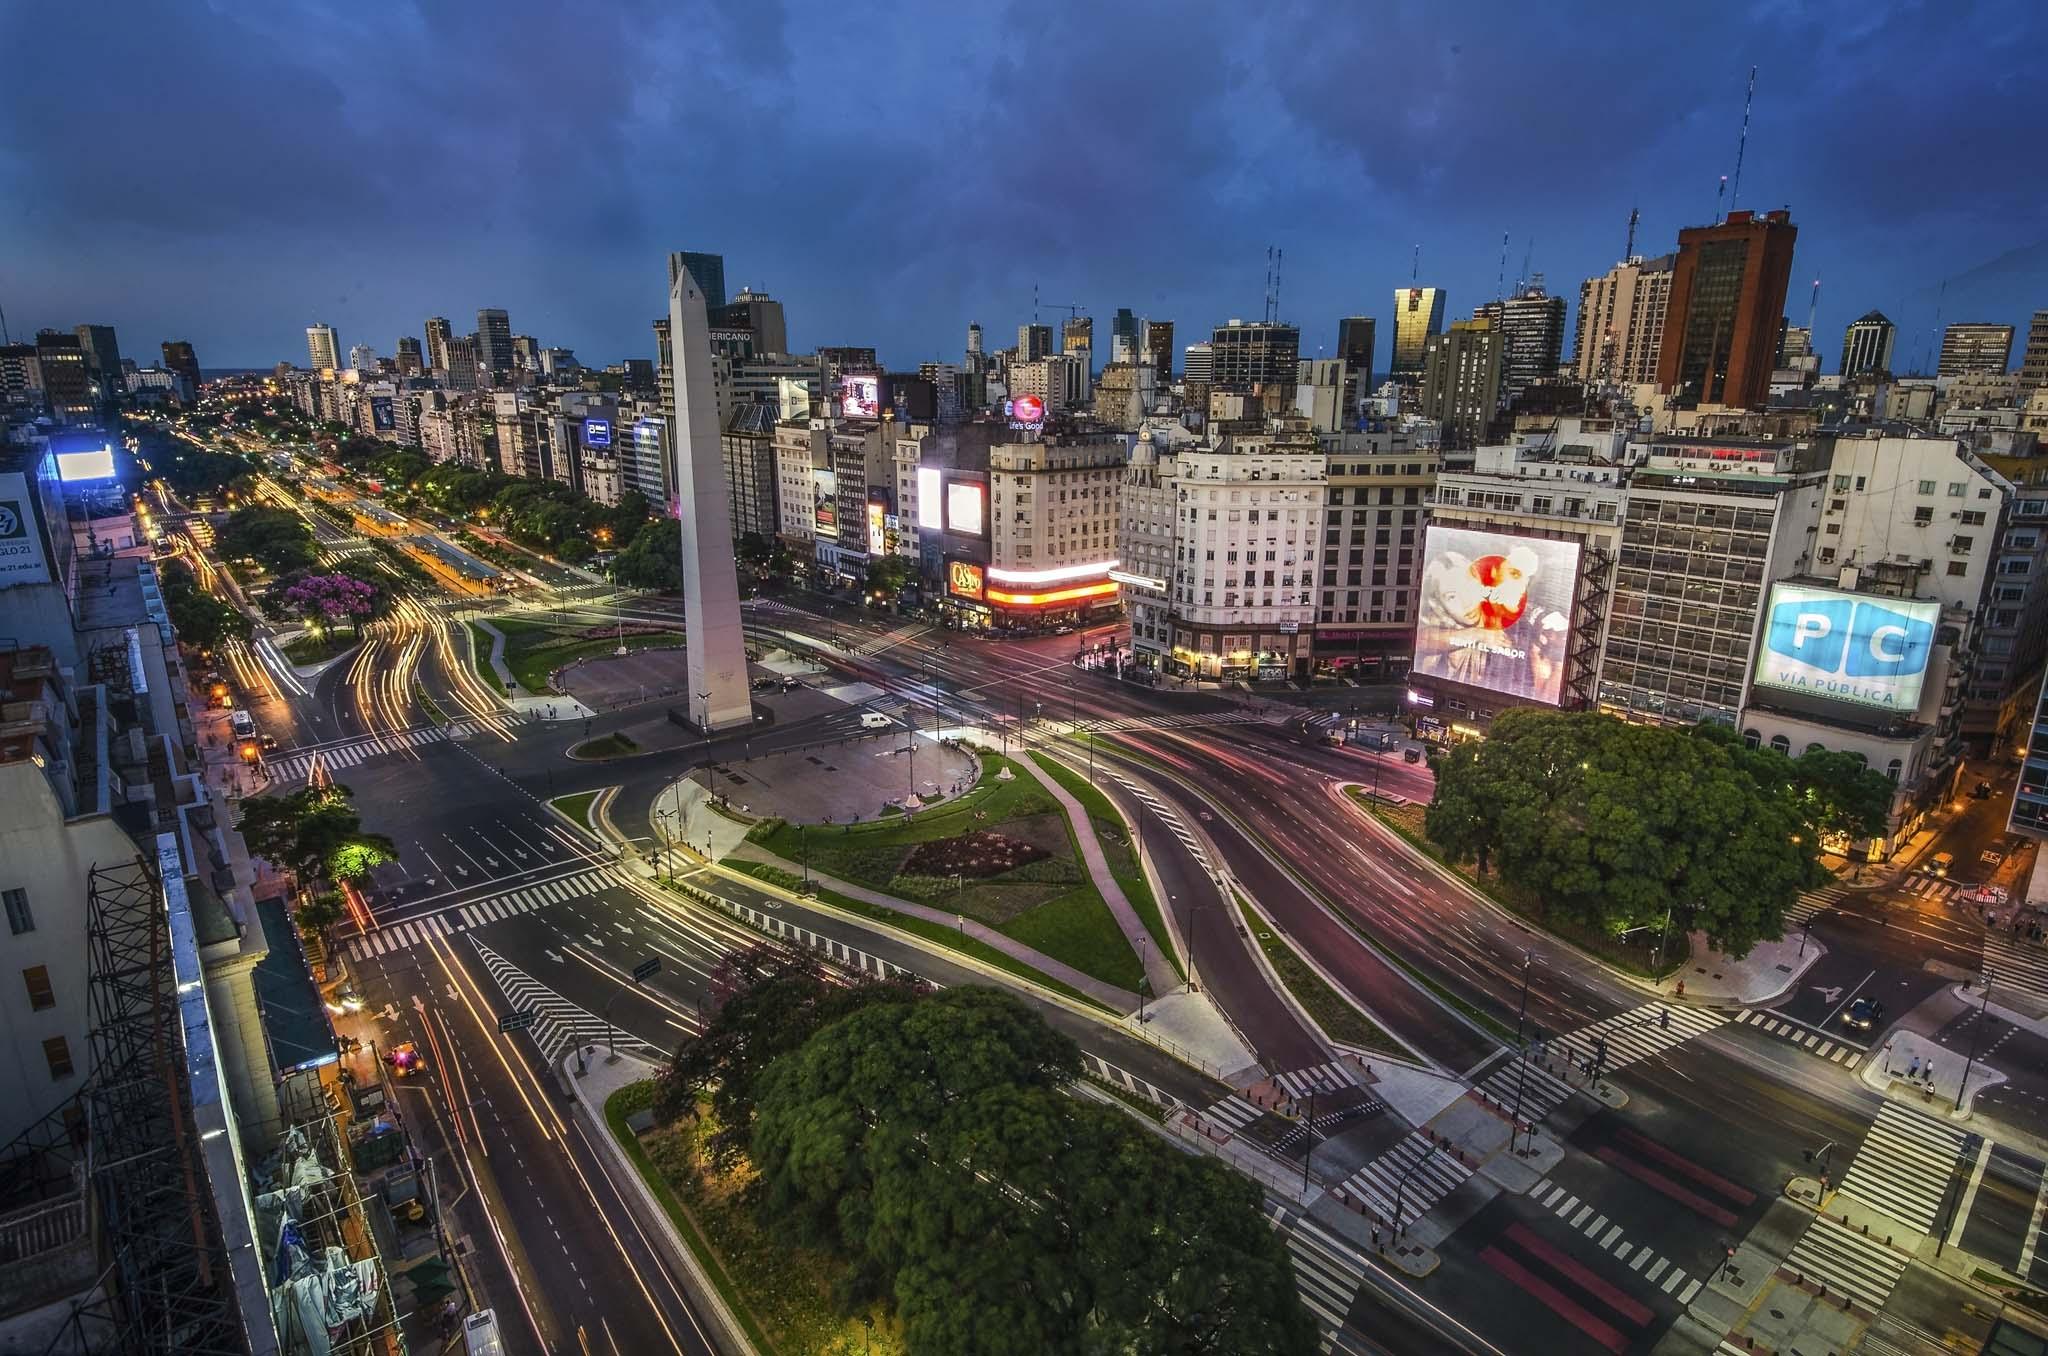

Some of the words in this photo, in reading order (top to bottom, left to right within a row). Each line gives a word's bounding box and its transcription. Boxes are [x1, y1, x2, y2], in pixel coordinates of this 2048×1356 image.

[708, 332, 751, 341] ERICANO
[1025, 421, 1044, 430] Good
[19, 545, 32, 554] 21
[1793, 613, 1832, 649] P
[1869, 625, 1909, 663] C
[1478, 642, 1489, 652] EL
[1491, 646, 1526, 660] SABOR
[1779, 671, 1807, 687] VÍA
[1815, 679, 1894, 704] PÚBLICA
